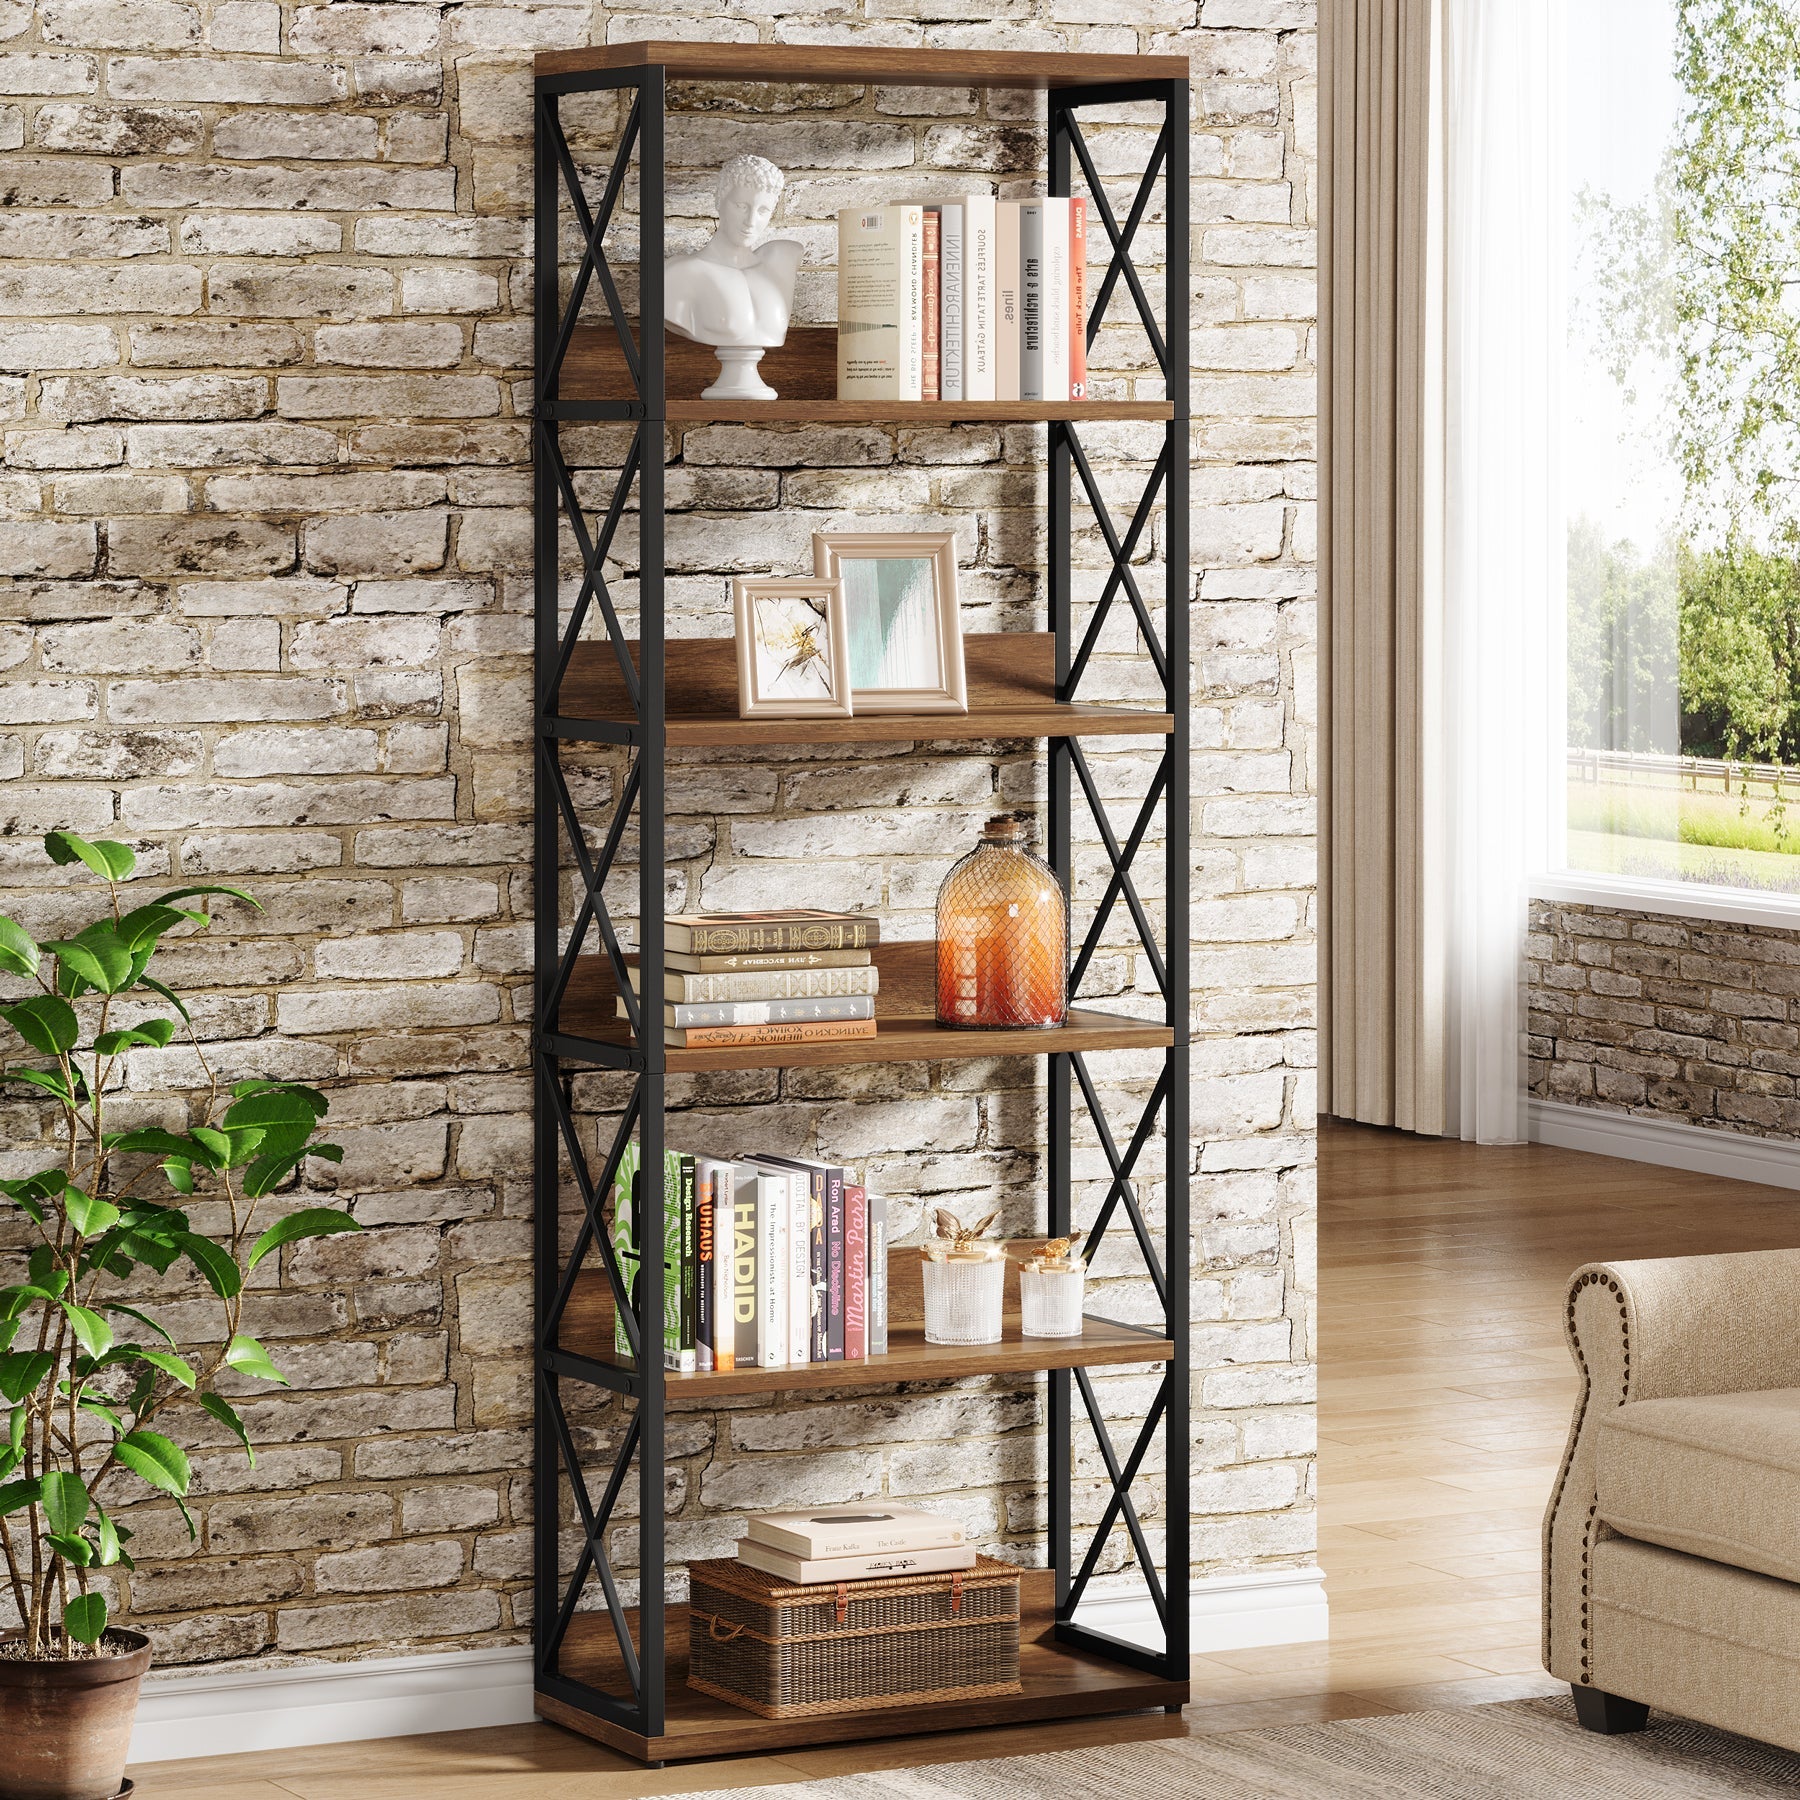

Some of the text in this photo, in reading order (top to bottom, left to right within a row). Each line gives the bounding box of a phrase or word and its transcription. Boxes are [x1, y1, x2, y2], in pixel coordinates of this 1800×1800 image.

[683, 1177, 693, 1211] Design
[699, 1183, 713, 1262] BAUHAUS
[795, 1174, 806, 1278] DIGITAL BY DESIGN
[847, 1190, 864, 1244] Parr
[685, 1213, 693, 1257] Research
[735, 1203, 755, 1323] HADID
[768, 1221, 776, 1285] Impressionists
[830, 1179, 841, 1316] Ron Arad No Discipline
[769, 1287, 775, 1296] at
[847, 1248, 864, 1328] Martin
